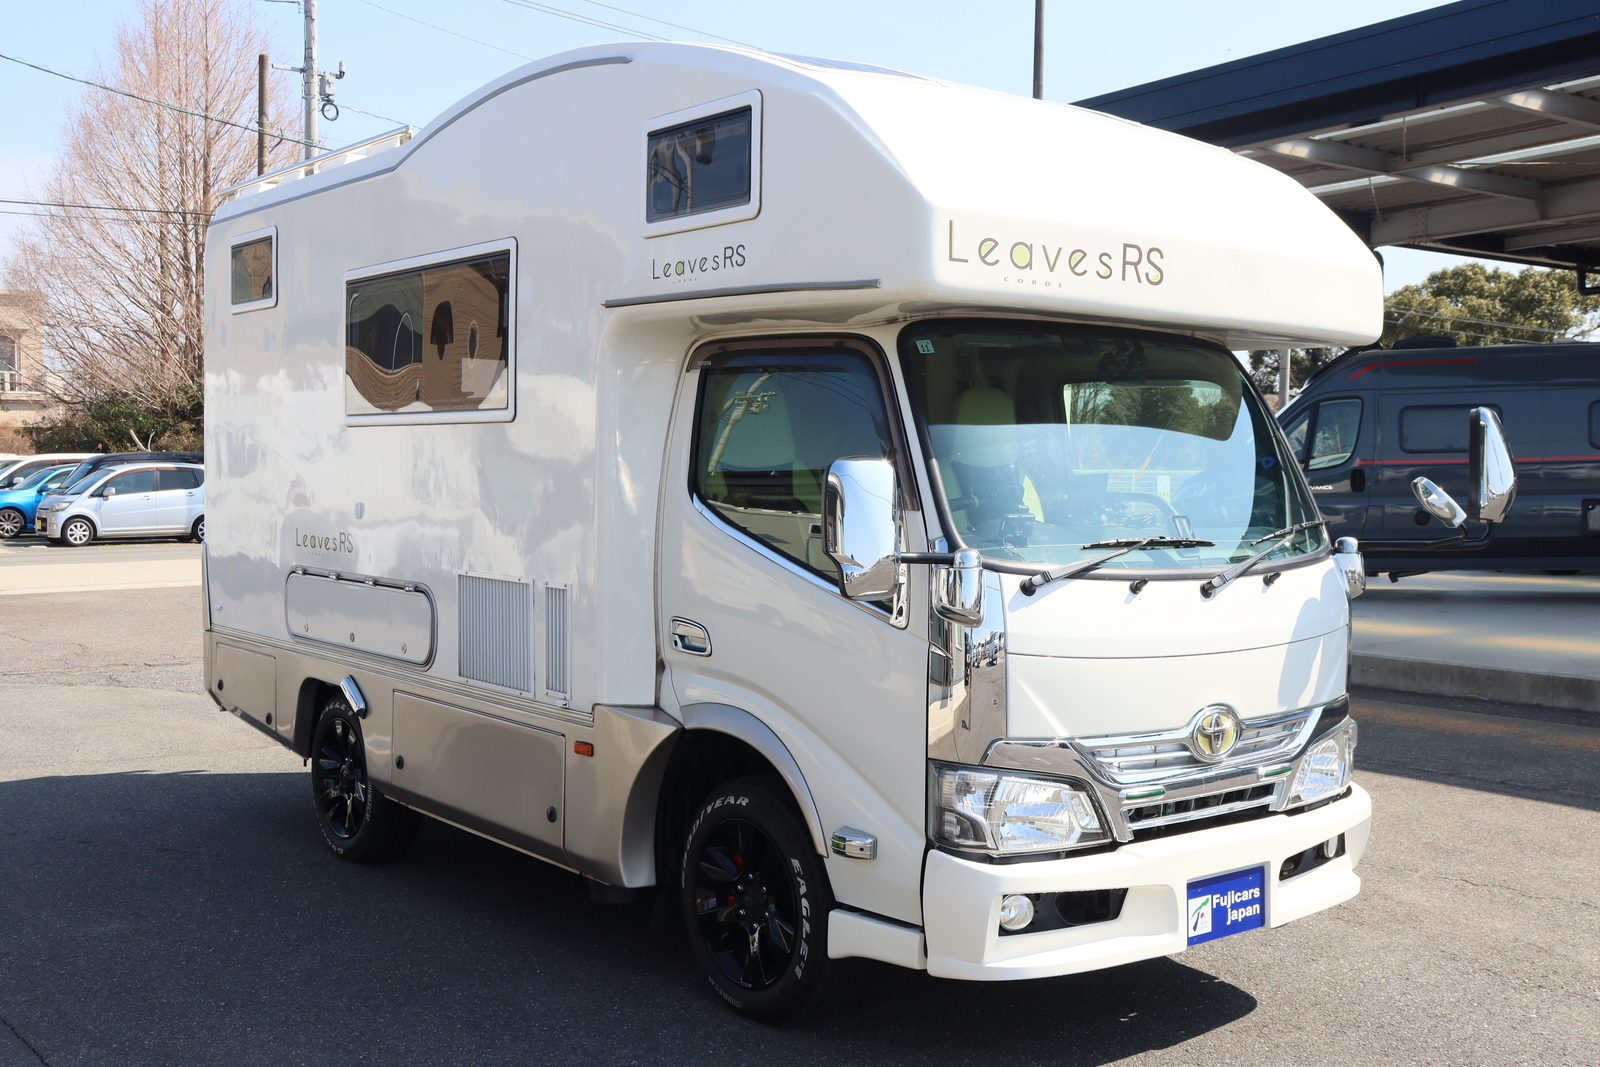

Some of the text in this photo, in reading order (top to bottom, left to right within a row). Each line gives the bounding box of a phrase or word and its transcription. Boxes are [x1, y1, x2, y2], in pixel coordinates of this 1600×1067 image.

[1003, 276, 1064, 288] CORDE
[1212, 887, 1261, 908] Fujicars
[790, 857, 811, 961] EAGLE
[1226, 903, 1261, 925] japan
